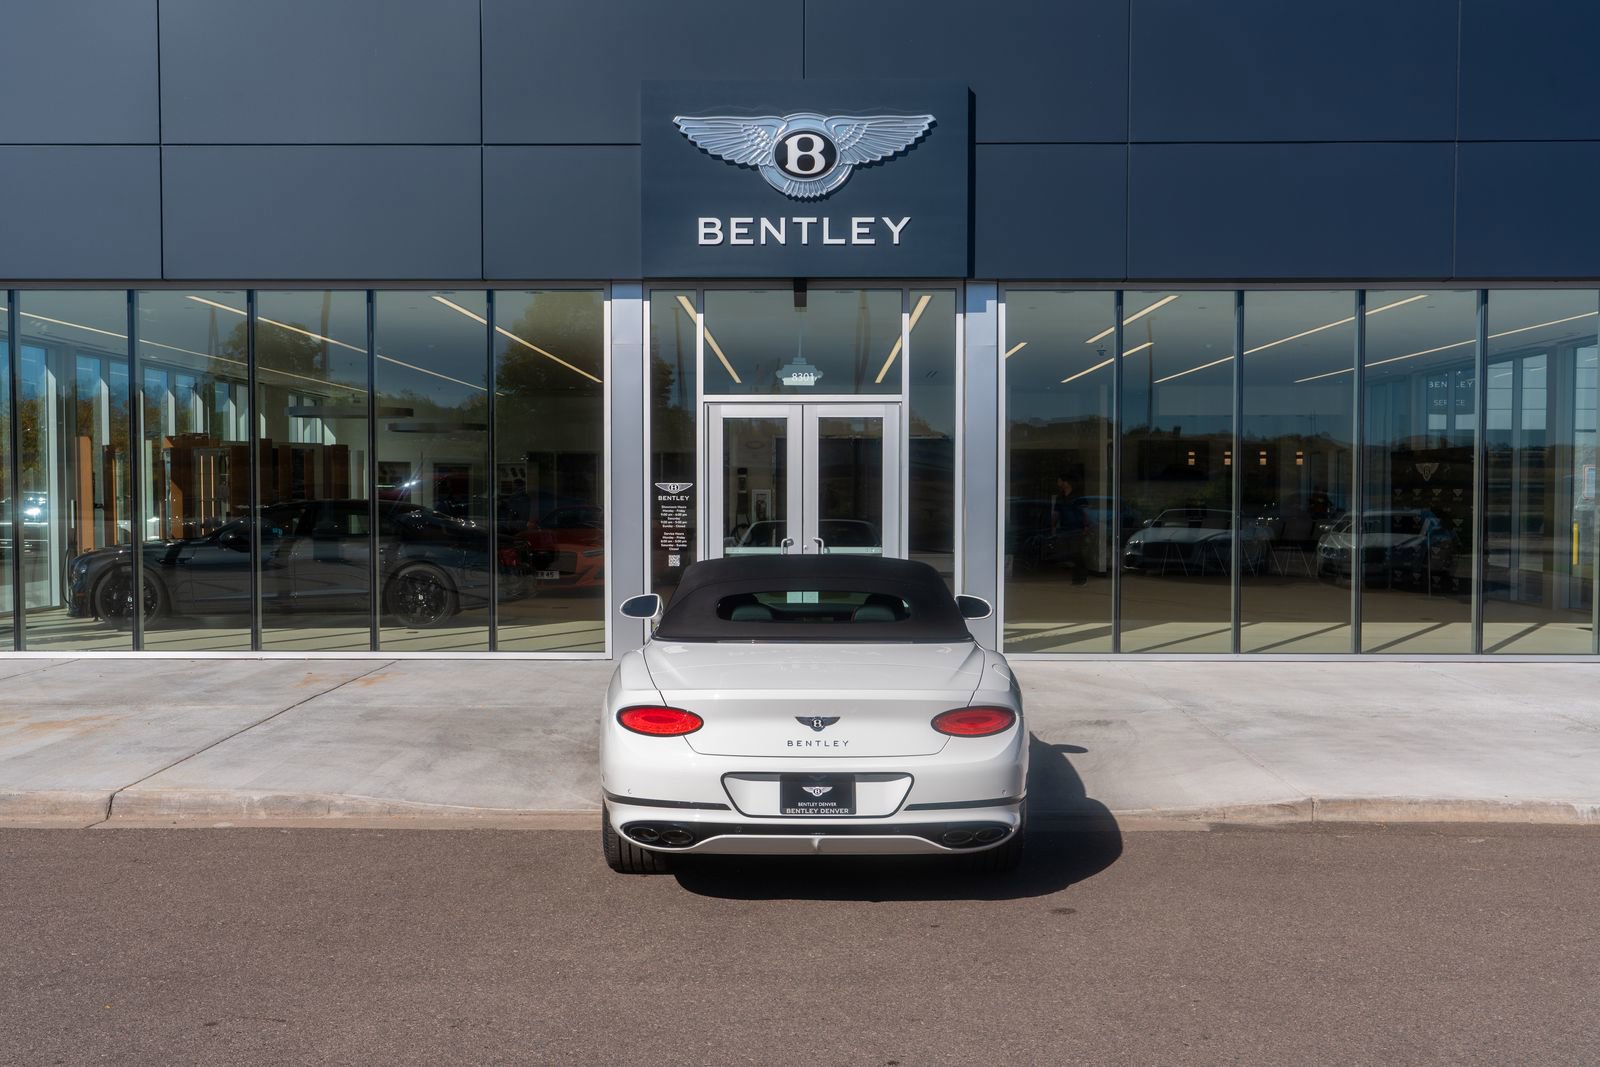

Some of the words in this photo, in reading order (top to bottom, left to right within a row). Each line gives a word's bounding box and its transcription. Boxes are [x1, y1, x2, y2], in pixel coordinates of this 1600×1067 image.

[785, 133, 826, 175] B
[697, 216, 912, 246] BENTLEY
[791, 372, 815, 382] 8301
[1428, 380, 1473, 388] BENLEY
